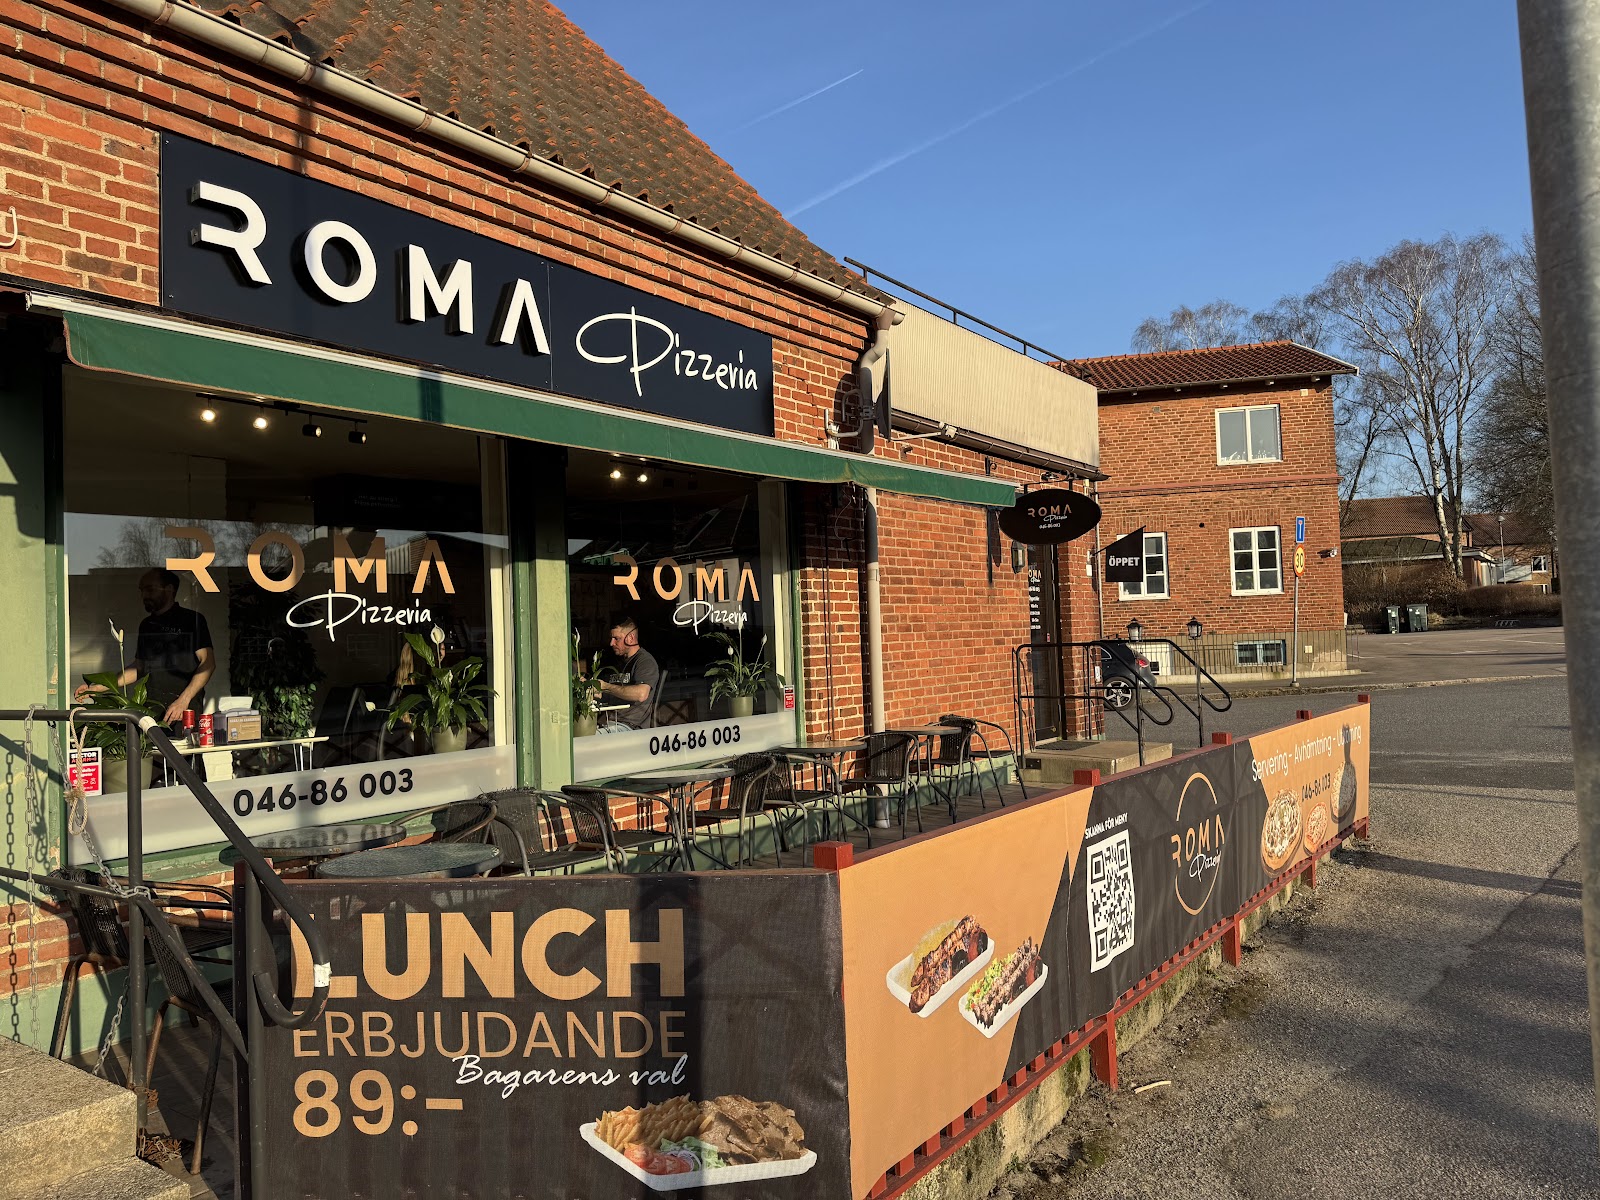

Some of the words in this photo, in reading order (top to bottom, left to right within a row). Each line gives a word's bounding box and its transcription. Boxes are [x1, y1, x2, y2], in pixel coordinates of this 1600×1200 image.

[190, 180, 550, 357] ROMA
[576, 306, 759, 396] Pizzeria
[1027, 503, 1072, 518] ROMA
[164, 526, 455, 595] ROMA
[613, 554, 760, 602] ROMA
[1028, 569, 1042, 579] OMA
[1108, 554, 1140, 567] ÖPPET
[1295, 552, 1304, 569] 30
[286, 589, 432, 642] Pizzeria
[672, 597, 748, 636] Pizzeria
[648, 729, 706, 756] 046-86
[711, 724, 741, 745] 003
[1251, 749, 1289, 782] Servering
[1294, 732, 1332, 765] Avhämtning
[233, 775, 348, 818] 046-86
[358, 768, 414, 797] 003
[1084, 822, 1106, 840] SKANNA
[1104, 816, 1115, 831] FÖR
[1170, 813, 1225, 868] ROMA
[290, 908, 685, 1000] LUNCH
[292, 1010, 687, 1059] ERBJUDANDE
[452, 1054, 621, 1100] Bagarens
[628, 1053, 688, 1086] val
[292, 1069, 464, 1138] 89:-
